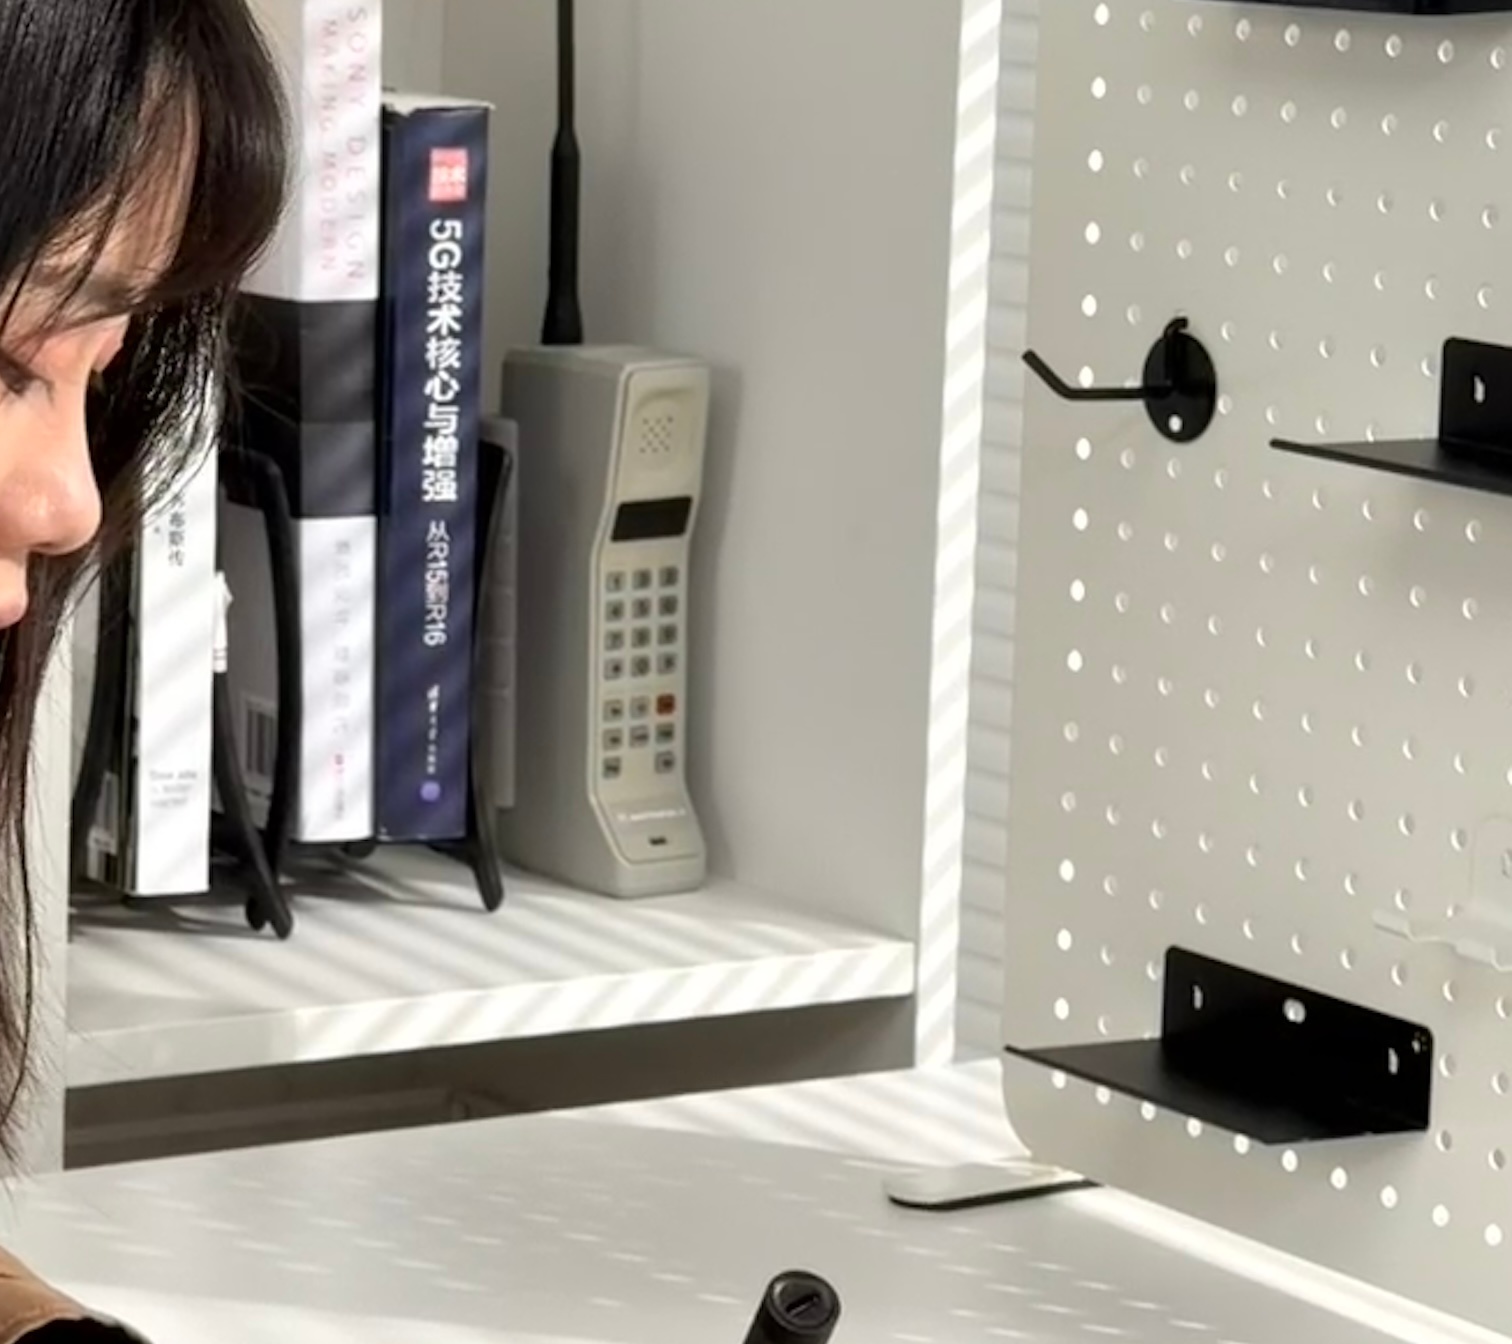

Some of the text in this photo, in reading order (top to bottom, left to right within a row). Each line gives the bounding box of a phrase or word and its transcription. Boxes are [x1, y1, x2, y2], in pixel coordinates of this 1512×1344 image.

[346, 5, 368, 282] SONY DESIGN
[422, 218, 465, 502] 5G技术核心与增强
